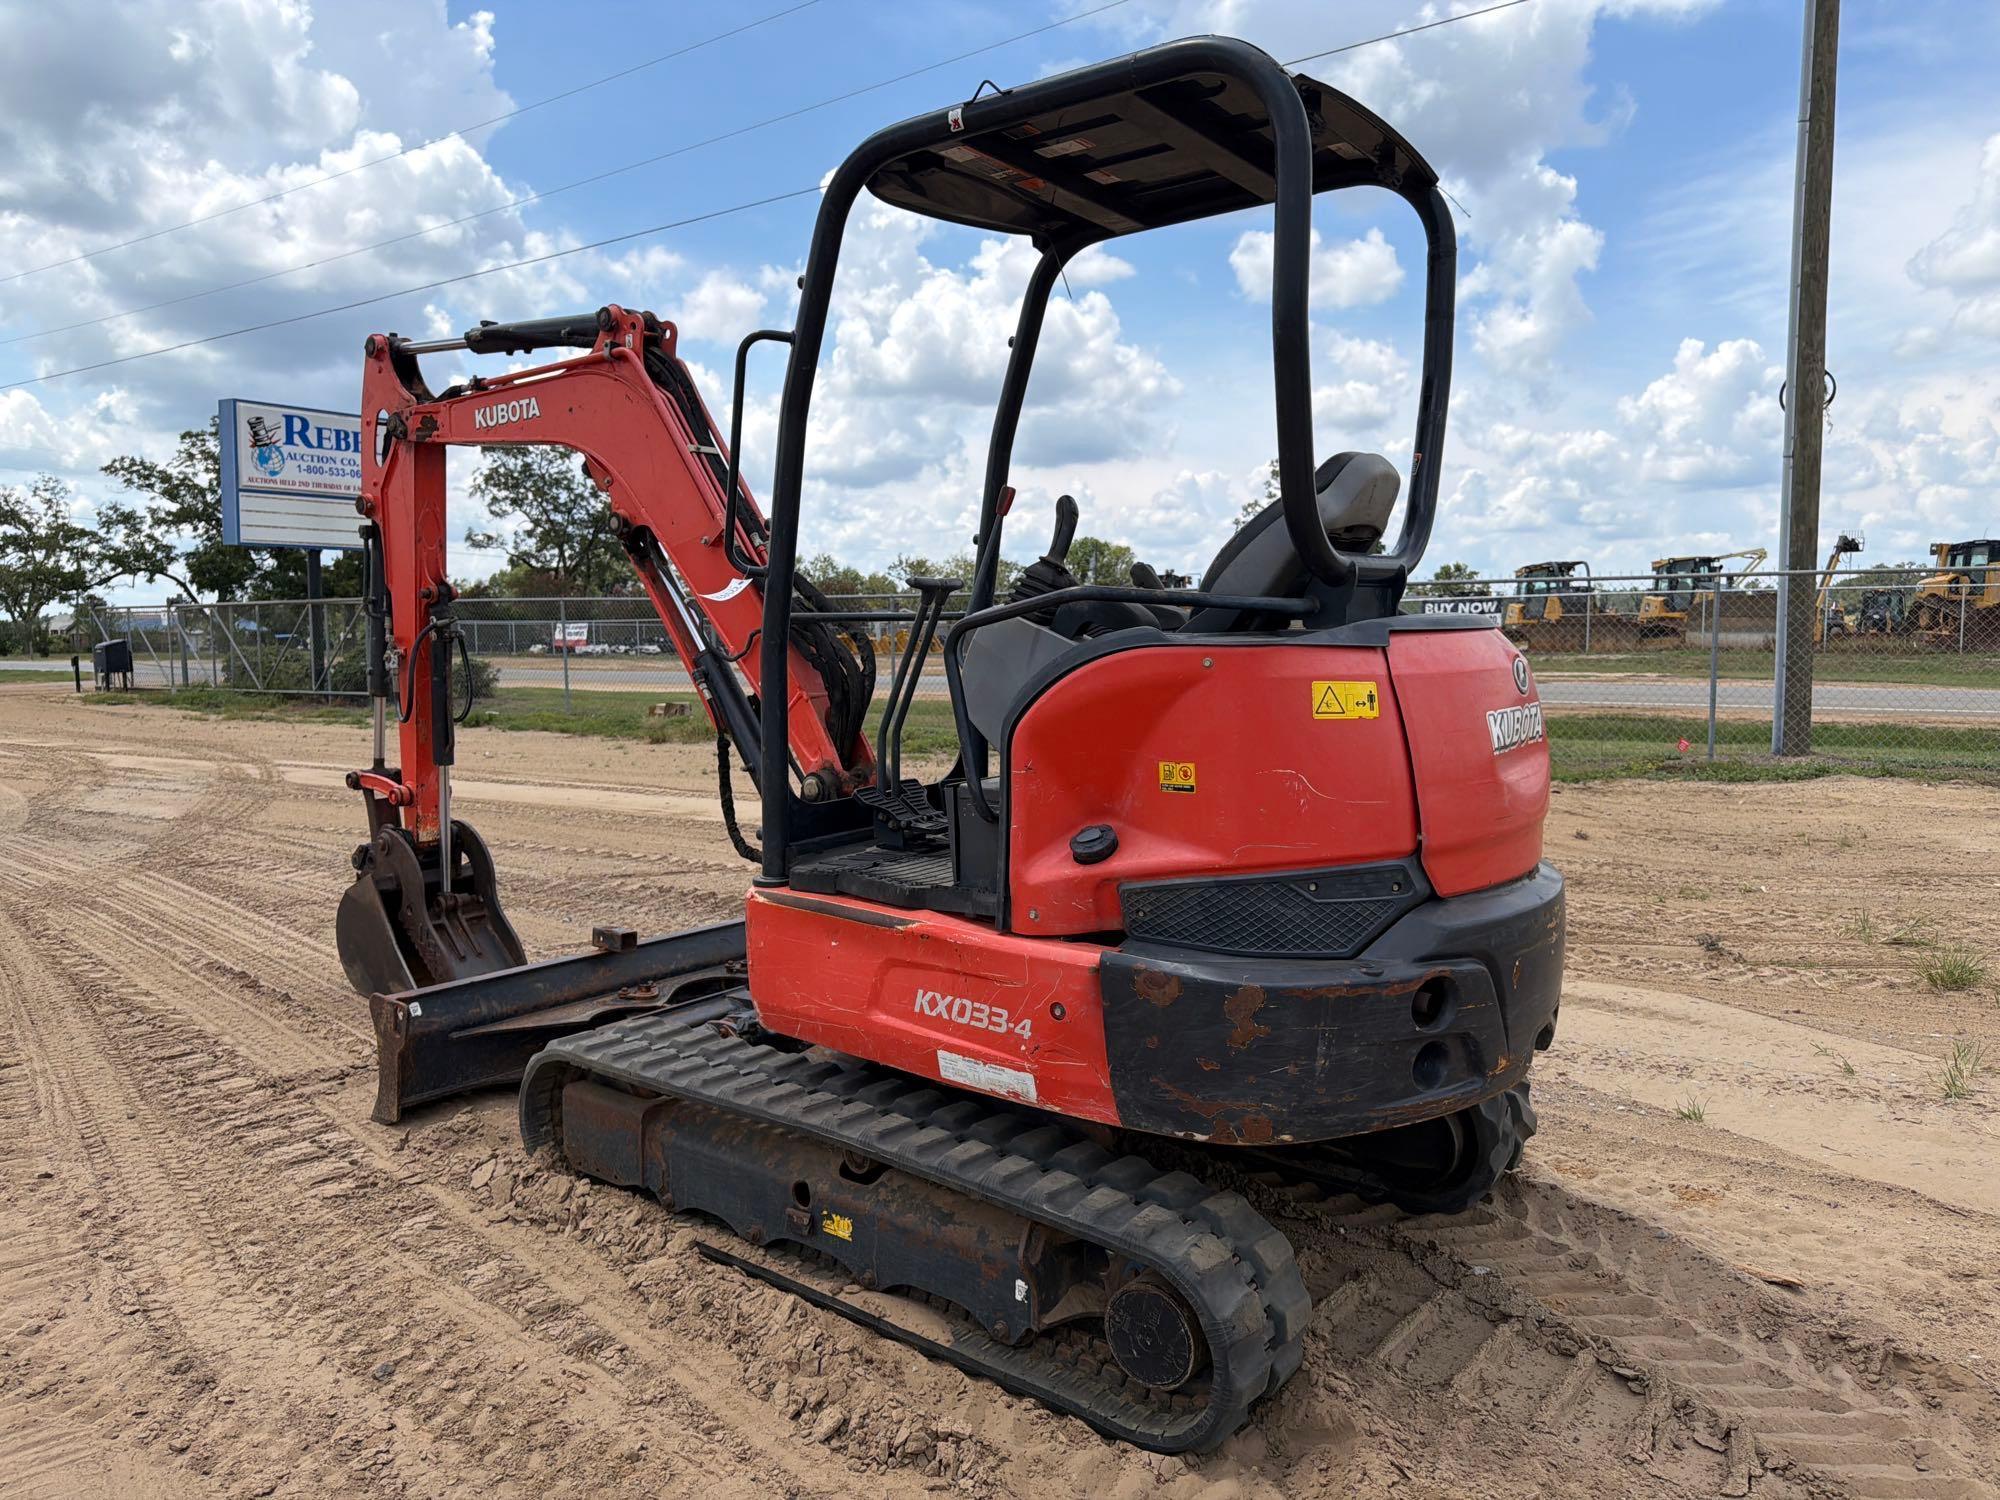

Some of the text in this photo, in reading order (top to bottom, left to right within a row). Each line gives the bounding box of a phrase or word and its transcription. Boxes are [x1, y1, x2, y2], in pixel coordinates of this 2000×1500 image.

[475, 396, 541, 430] KUBOTA
[286, 452, 337, 465] AUCTION
[247, 477, 278, 486] AUCTIONS
[279, 479, 297, 487] HELD
[312, 482, 342, 491] THURSDAY
[1424, 601, 1498, 614] BUY NOW
[1486, 703, 1542, 753] KUBOTA
[914, 989, 1032, 1040] KX033-4
